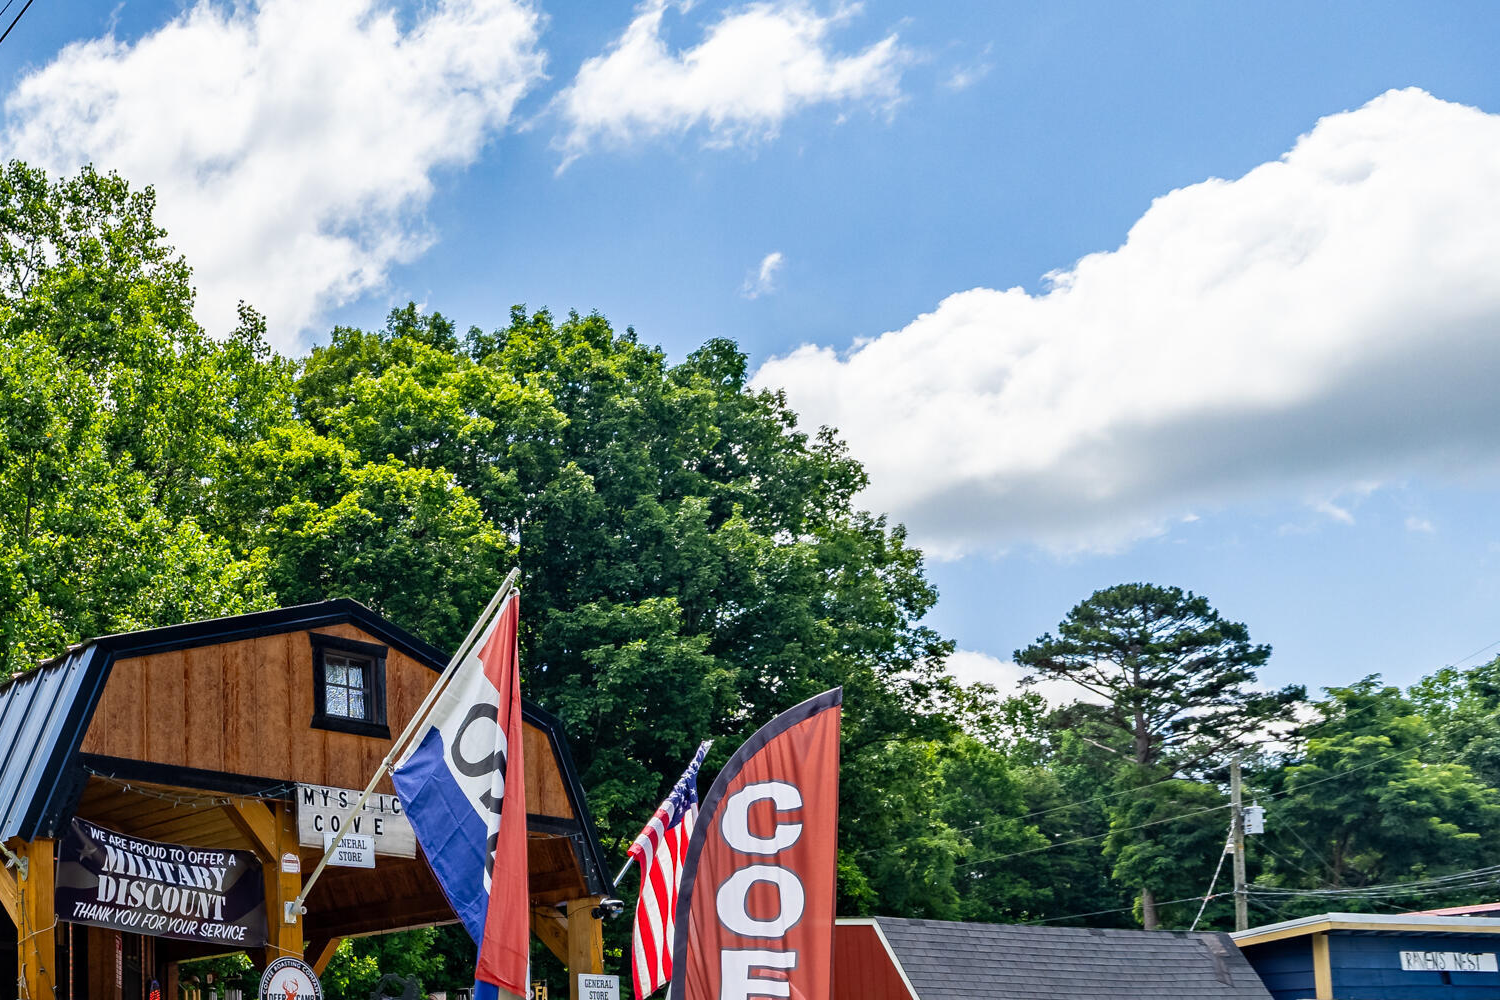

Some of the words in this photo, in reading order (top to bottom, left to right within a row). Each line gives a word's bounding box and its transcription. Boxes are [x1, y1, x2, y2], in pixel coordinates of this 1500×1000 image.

[314, 814, 383, 836] COVE
[90, 826, 106, 842] WE
[108, 834, 128, 850] ARE
[129, 840, 167, 860] PROUD
[169, 848, 185, 862] TO
[188, 851, 225, 866] OFFER
[228, 854, 237, 867] A
[338, 851, 363, 862] STORE
[101, 844, 227, 893] MILITARY
[96, 874, 227, 921] DISCOUNT
[72, 901, 111, 922] THANK
[113, 908, 139, 928] YOU
[141, 914, 168, 931] FOR
[167, 918, 198, 936] YOUR
[199, 923, 248, 941] SERVICE
[262, 969, 276, 995] COFFEE
[274, 960, 301, 972] ROASTING
[301, 966, 320, 997] COMPANY
[584, 978, 614, 989] GENERAL
[589, 991, 609, 1000] STORE
